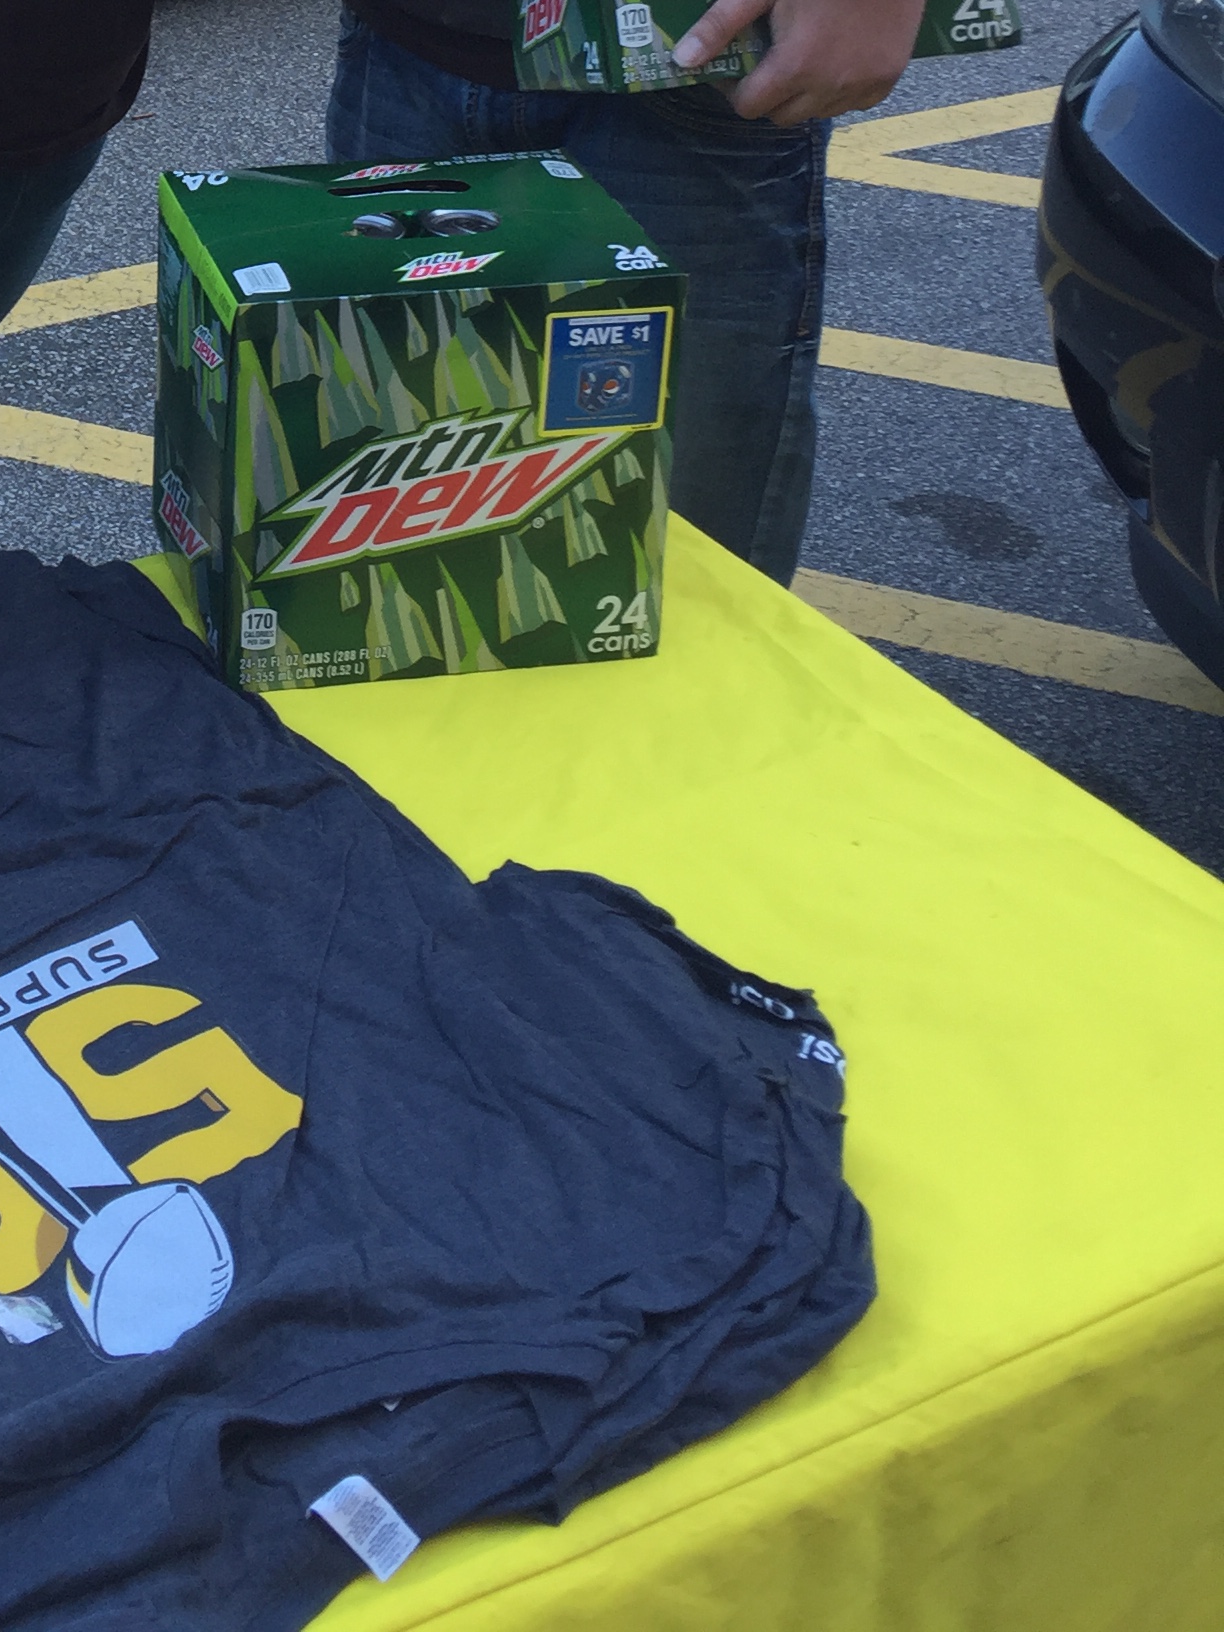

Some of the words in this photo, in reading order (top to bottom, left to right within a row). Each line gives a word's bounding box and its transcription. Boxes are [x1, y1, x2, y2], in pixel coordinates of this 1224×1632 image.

[622, 8, 647, 26] 170
[950, 20, 1013, 42] cans
[607, 244, 659, 261] 24
[568, 326, 625, 347] SAVE
[631, 325, 650, 342] $1
[308, 421, 504, 503] Mtn
[246, 613, 273, 630] 170
[593, 591, 648, 634] 24
[587, 632, 651, 653] cans
[239, 657, 267, 670] 24-12
[286, 654, 298, 666] OZ
[302, 651, 331, 665] CANS
[333, 649, 356, 663] (288
[359, 648, 371, 660] FL
[239, 671, 275, 685] 24-355
[278, 669, 292, 681] mL
[296, 666, 324, 680] CANS
[326, 664, 351, 678] (8.52
[354, 662, 365, 675] L)
